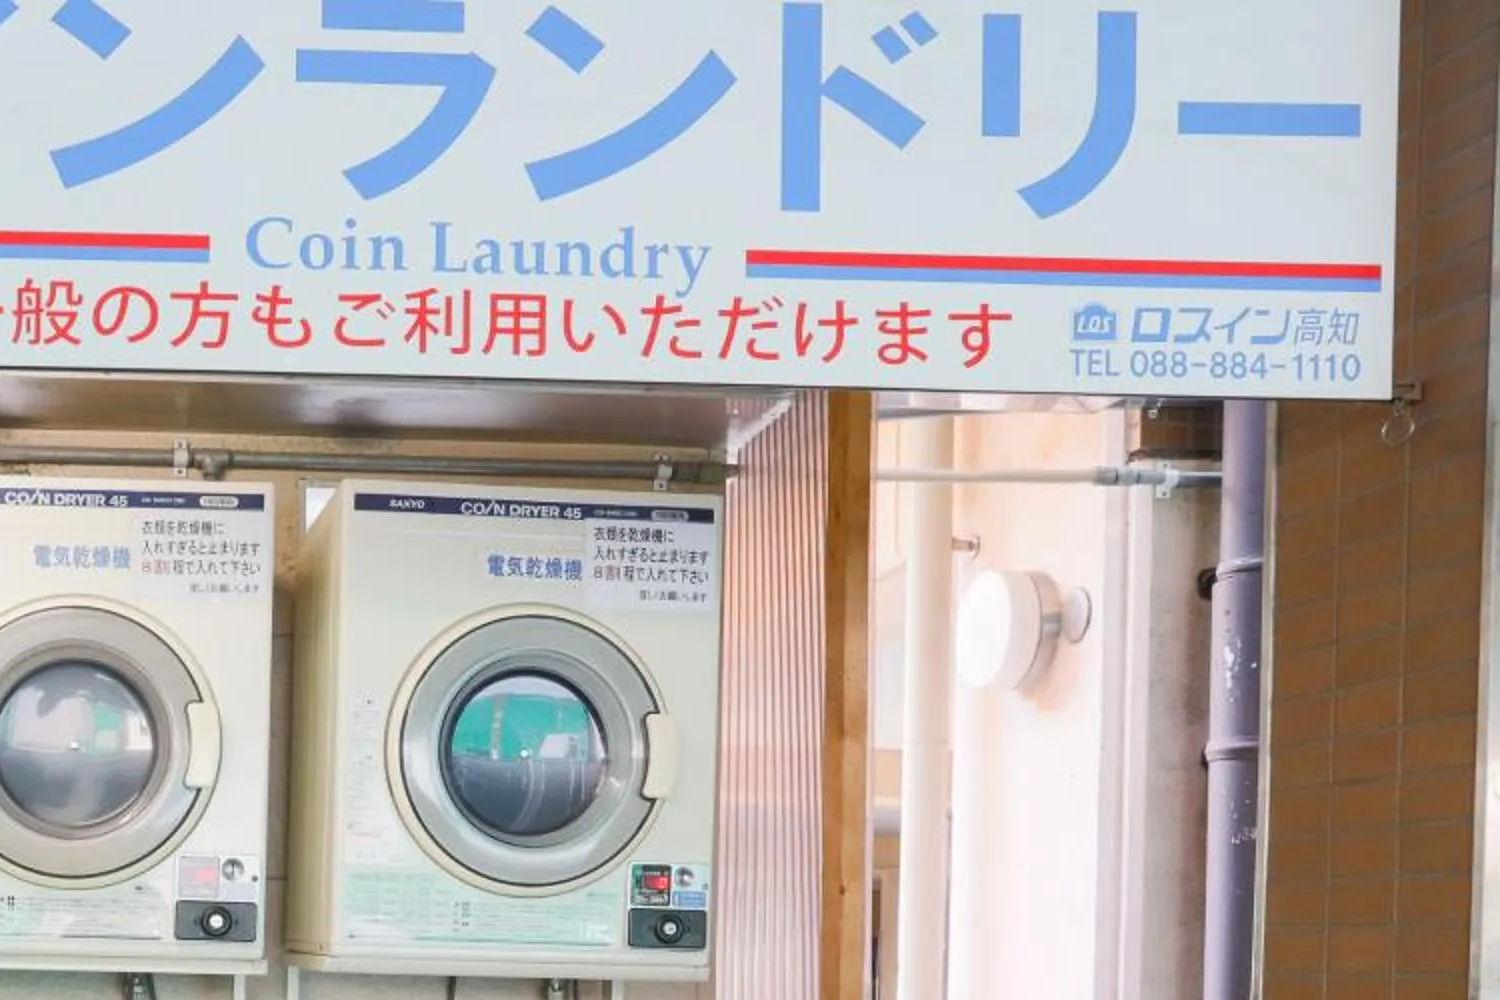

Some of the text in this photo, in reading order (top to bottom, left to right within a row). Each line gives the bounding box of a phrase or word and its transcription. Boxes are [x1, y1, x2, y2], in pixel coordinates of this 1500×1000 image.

[246, 217, 711, 299] Coin Laundry
[1131, 306, 1360, 346] ロスイン高知
[1070, 349, 1361, 382] TEL 088-884-1110
[53, 493, 105, 508] DRYER
[109, 495, 129, 508] 45
[509, 503, 561, 519] DRYER
[564, 506, 582, 520] 45
[33, 544, 132, 570] 電気乾燥機
[487, 553, 583, 581] 電気乾燥機
